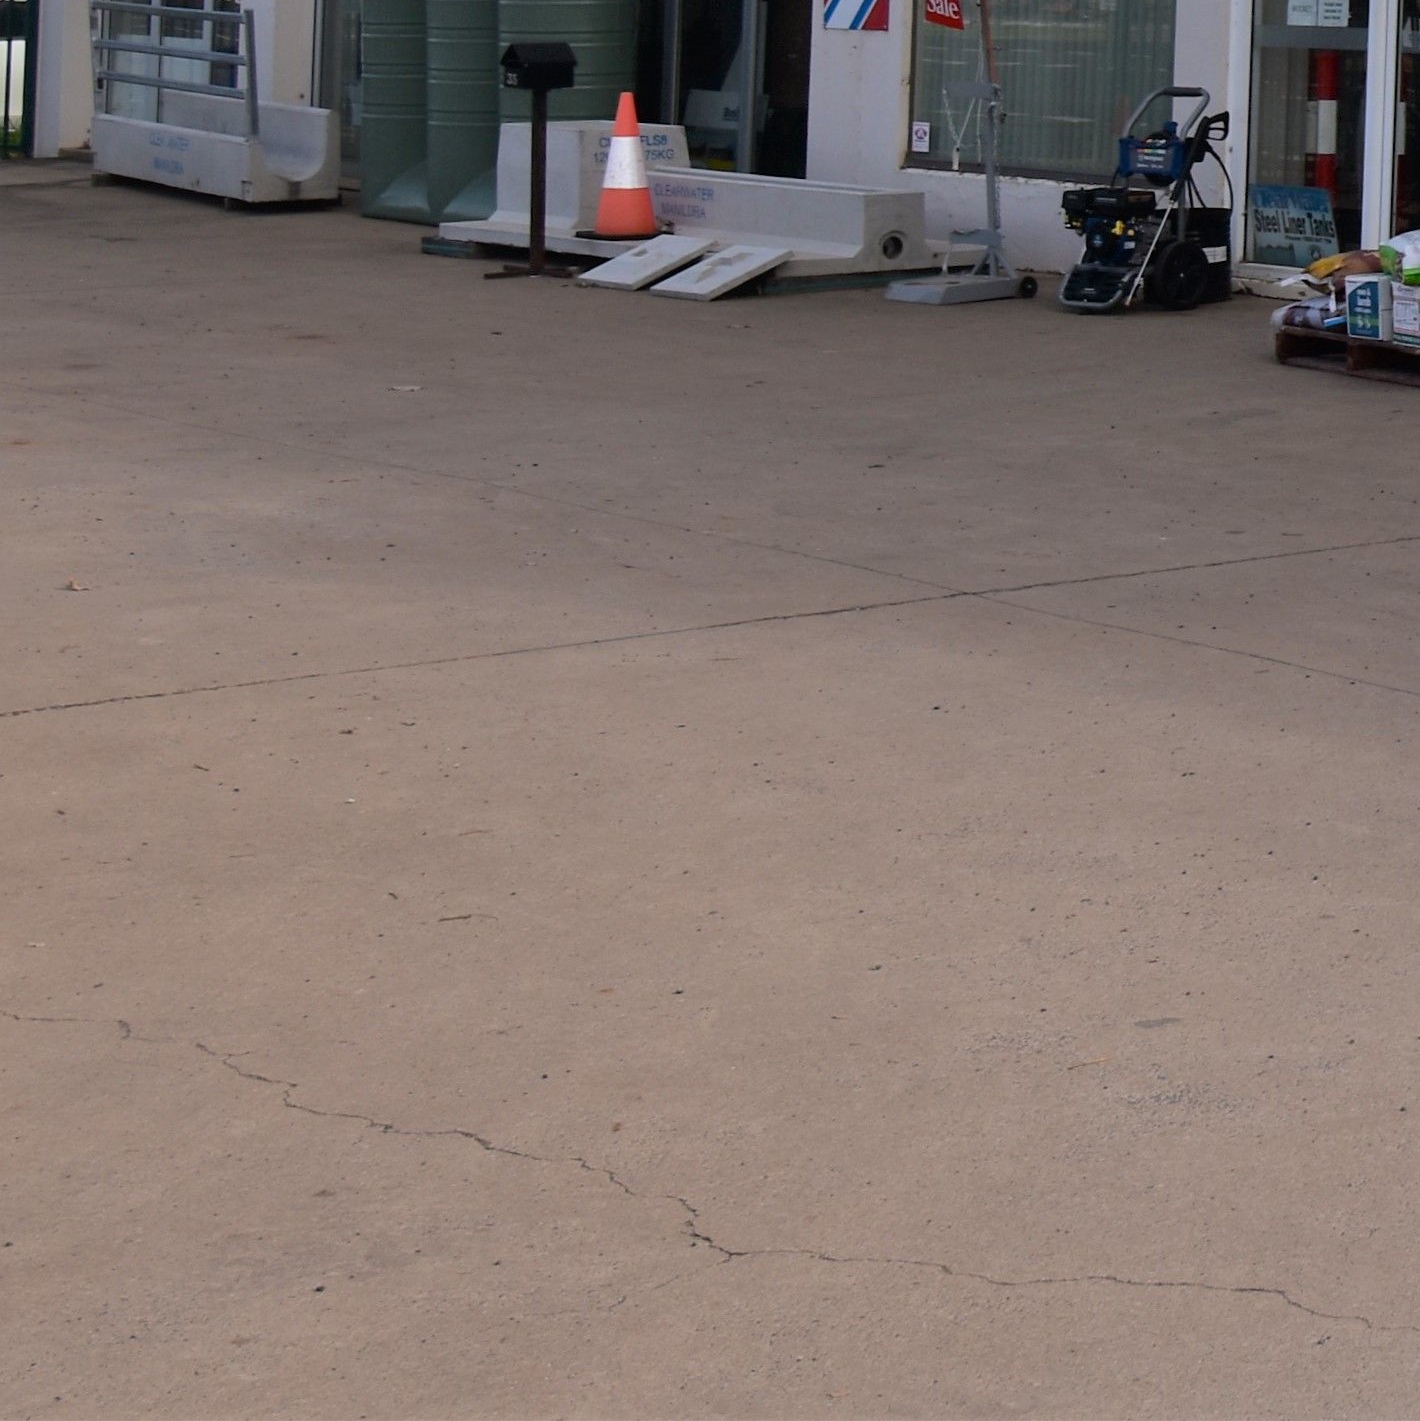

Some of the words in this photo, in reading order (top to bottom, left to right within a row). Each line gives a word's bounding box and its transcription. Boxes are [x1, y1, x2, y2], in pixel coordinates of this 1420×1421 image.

[1254, 208, 1281, 233] Steel
[1282, 210, 1306, 235] Liner
[1306, 211, 1335, 238] Tanks
